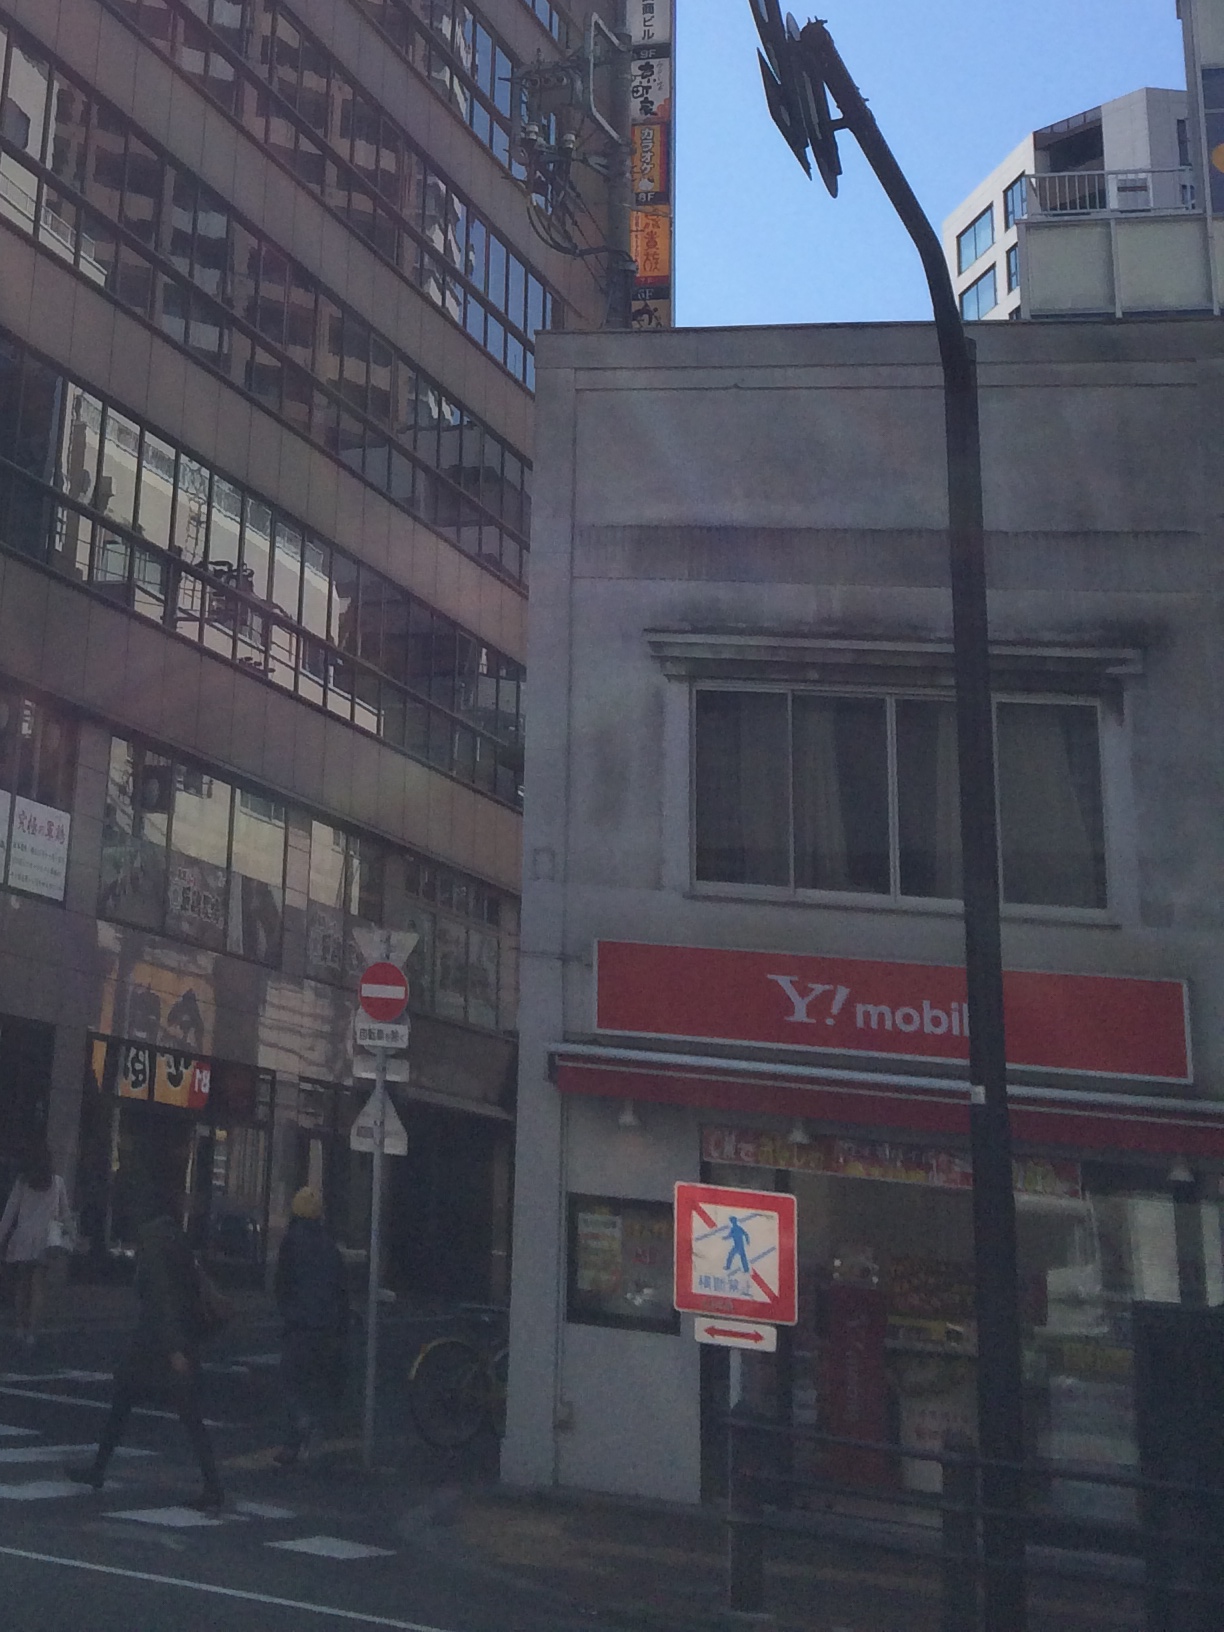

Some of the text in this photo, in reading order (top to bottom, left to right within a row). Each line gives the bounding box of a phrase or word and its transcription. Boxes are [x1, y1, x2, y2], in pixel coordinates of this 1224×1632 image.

[640, 50, 657, 59] 9F
[640, 128, 655, 176] カラオケ
[638, 191, 655, 203] 8F
[768, 973, 970, 1037] Y!mobil
[698, 1274, 754, 1299] 横断禁止
